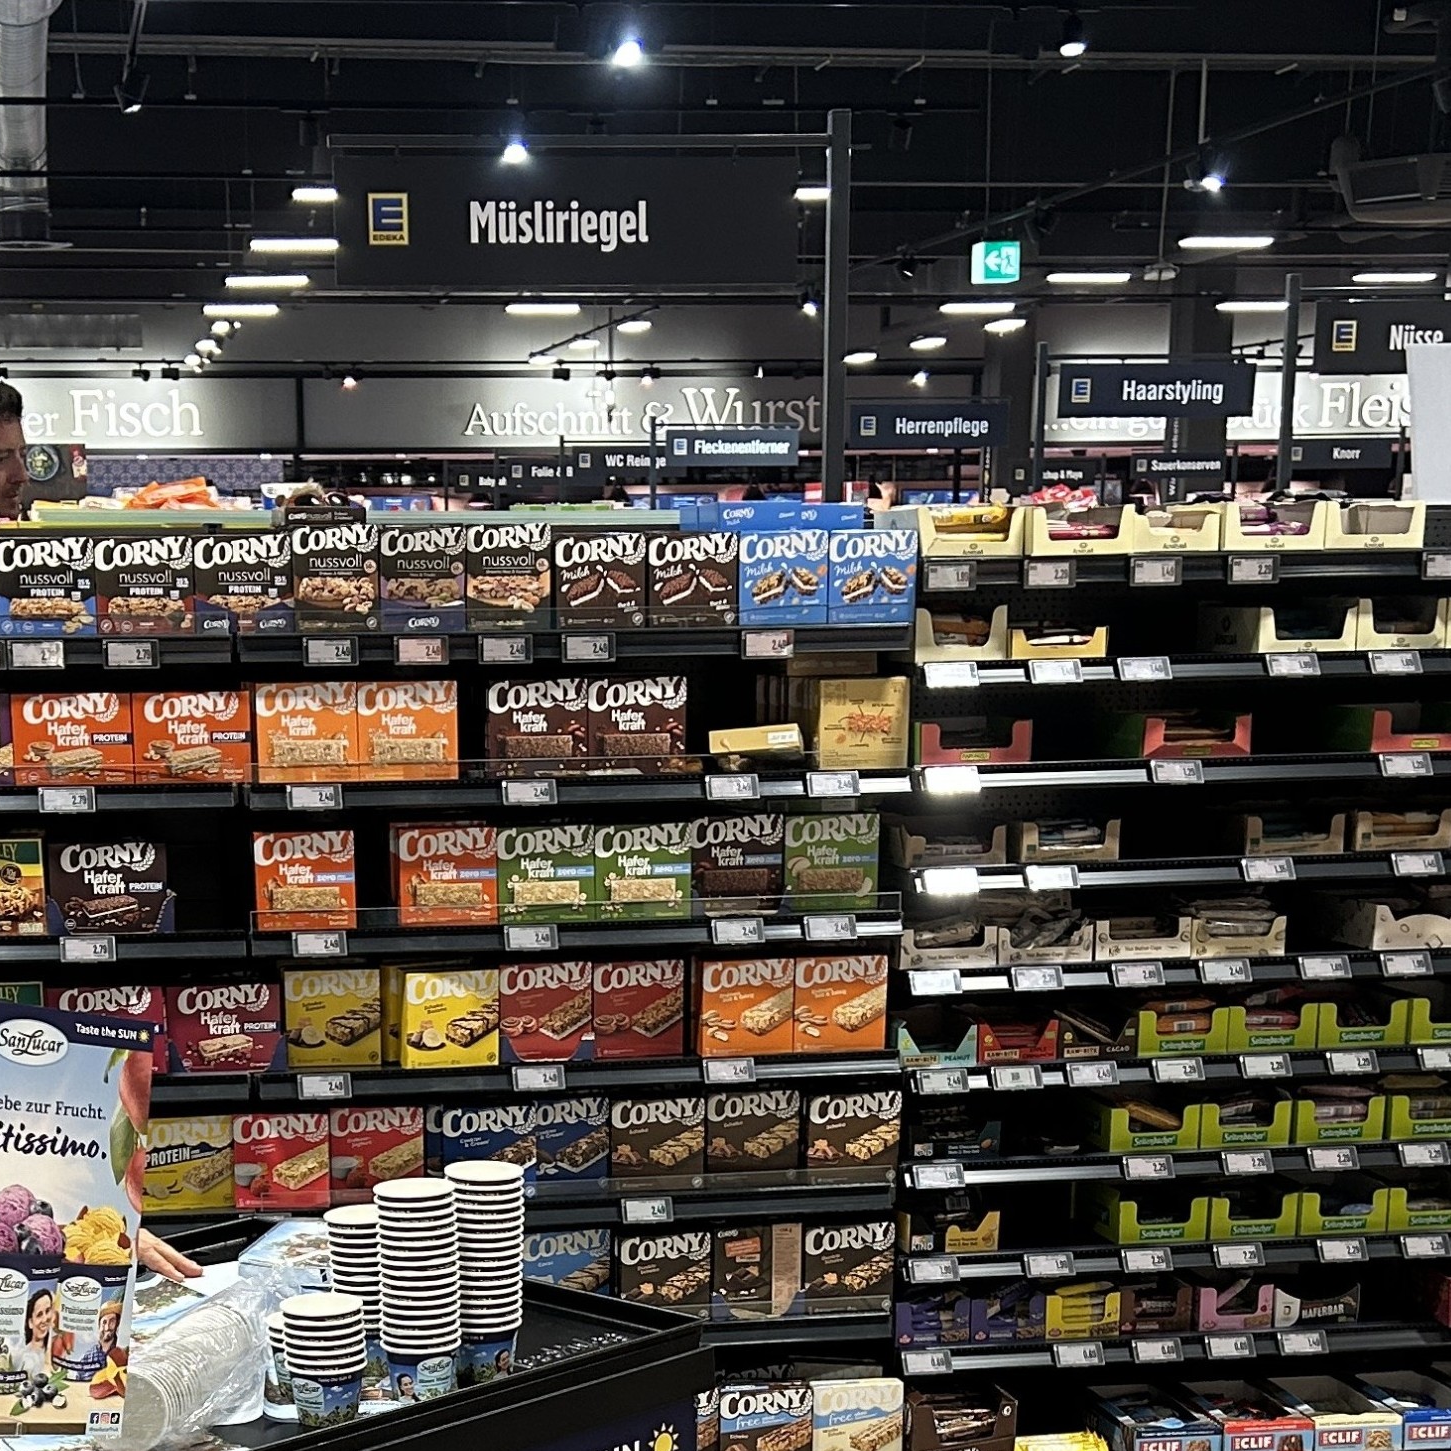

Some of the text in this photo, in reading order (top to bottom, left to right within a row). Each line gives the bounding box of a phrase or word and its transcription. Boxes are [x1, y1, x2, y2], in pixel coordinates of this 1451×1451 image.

[372, 233, 406, 243] EDEKA
[469, 200, 649, 252] Müsliriegel
[1389, 324, 1445, 350] Nüsse
[1122, 379, 1224, 405] Haarstyling
[71, 389, 204, 438] Fisch
[464, 388, 821, 436] Aufschnitt & Wurst
[895, 417, 989, 437] Herrenpflege
[605, 454, 624, 467] WC
[694, 439, 791, 456] Fleckenentferner
[1333, 447, 1361, 461] Knorr
[1151, 460, 1221, 472] Sauerkonserven
[293, 524, 373, 555] CORNY
[554, 533, 640, 567] CORNY
[739, 531, 823, 564] CORNY
[19, 572, 74, 587] nussvoll
[560, 565, 591, 581] Milch
[22, 693, 112, 723] CORNY
[488, 678, 579, 712] CORNY
[47, 722, 86, 737] Hafer
[56, 733, 128, 747] kraft PROTEIN
[61, 843, 146, 872] CORNY
[255, 831, 347, 866] CORNY
[702, 962, 786, 992] CORNY
[75, 1022, 138, 1041] Taste the SUN
[25, 1101, 51, 1115] zur
[55, 1102, 107, 1121] Frucht.
[808, 1091, 889, 1124] CORNY
[1301, 1303, 1346, 1322] HAFERBAR
[720, 1388, 804, 1419] CORNY
